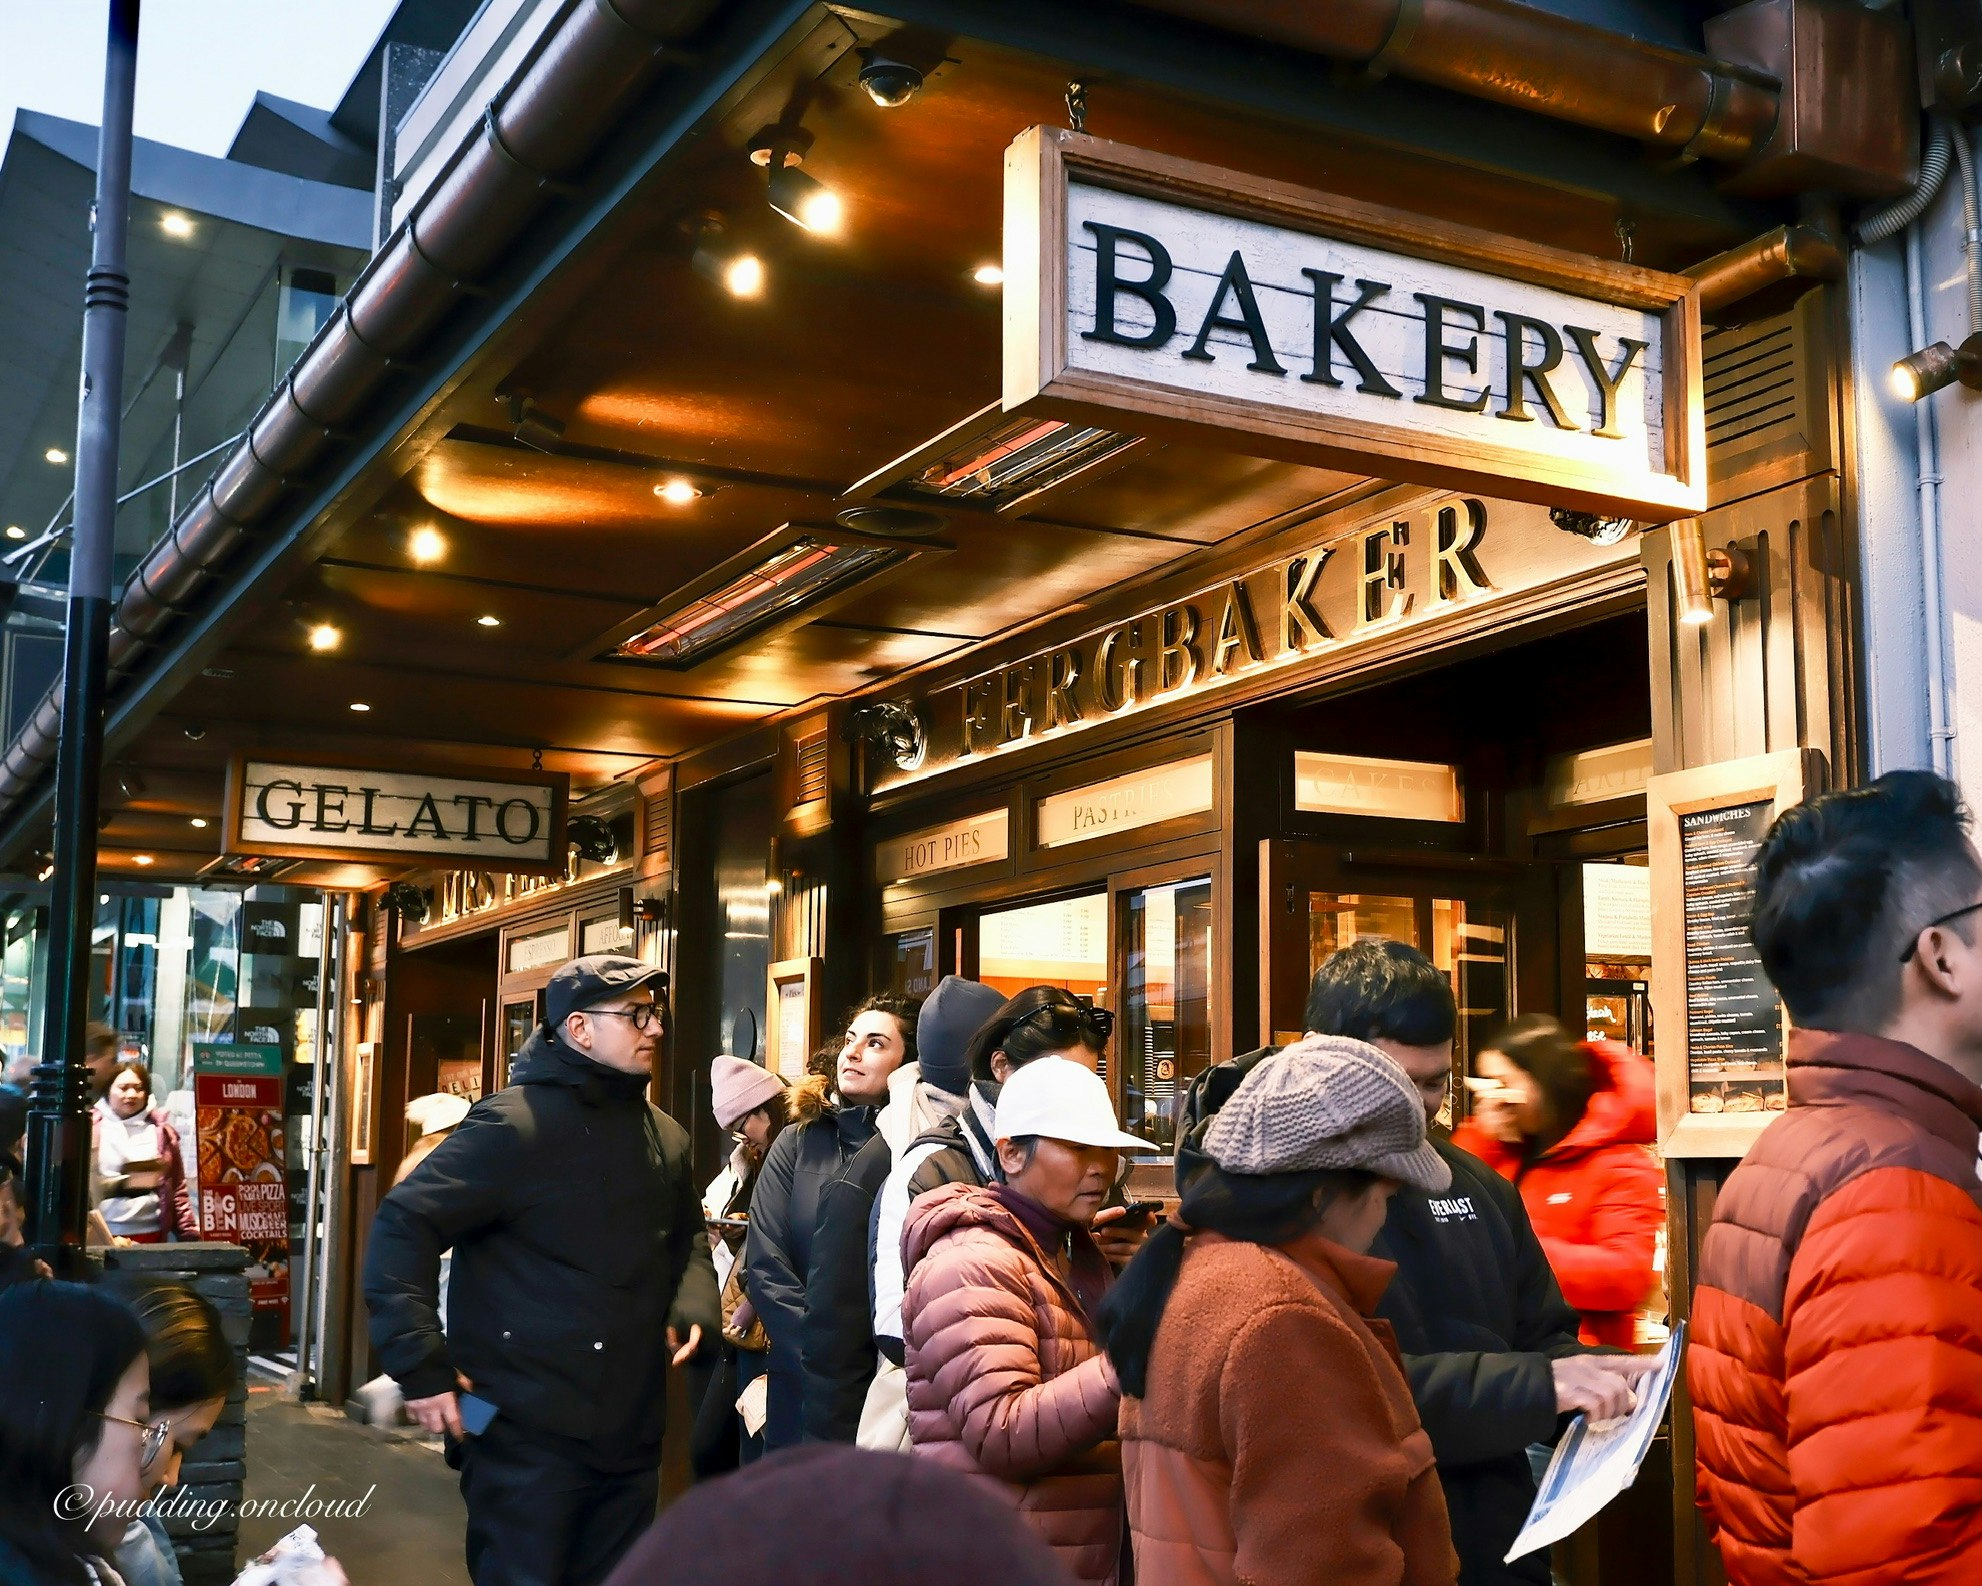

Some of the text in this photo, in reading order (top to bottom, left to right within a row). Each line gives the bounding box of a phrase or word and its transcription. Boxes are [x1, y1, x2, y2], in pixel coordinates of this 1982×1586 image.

[1081, 220, 1650, 440] BAKERY
[957, 498, 1499, 761] FERGBAKER
[1313, 767, 1436, 801] CAKES
[256, 779, 540, 845] GELATO
[1073, 779, 1173, 830] PASTRIES
[1684, 808, 1751, 828] SANDWICHES
[904, 829, 980, 871] HOT PIES
[222, 1083, 257, 1099] LONDON
[239, 1184, 260, 1193] POOL
[261, 1183, 286, 1200] PIZZA
[240, 1200, 285, 1211] LIVE SPORT
[1428, 1197, 1474, 1216] EVERLAST
[203, 1213, 237, 1232] BEN
[240, 1230, 288, 1240] COCKTAILS
